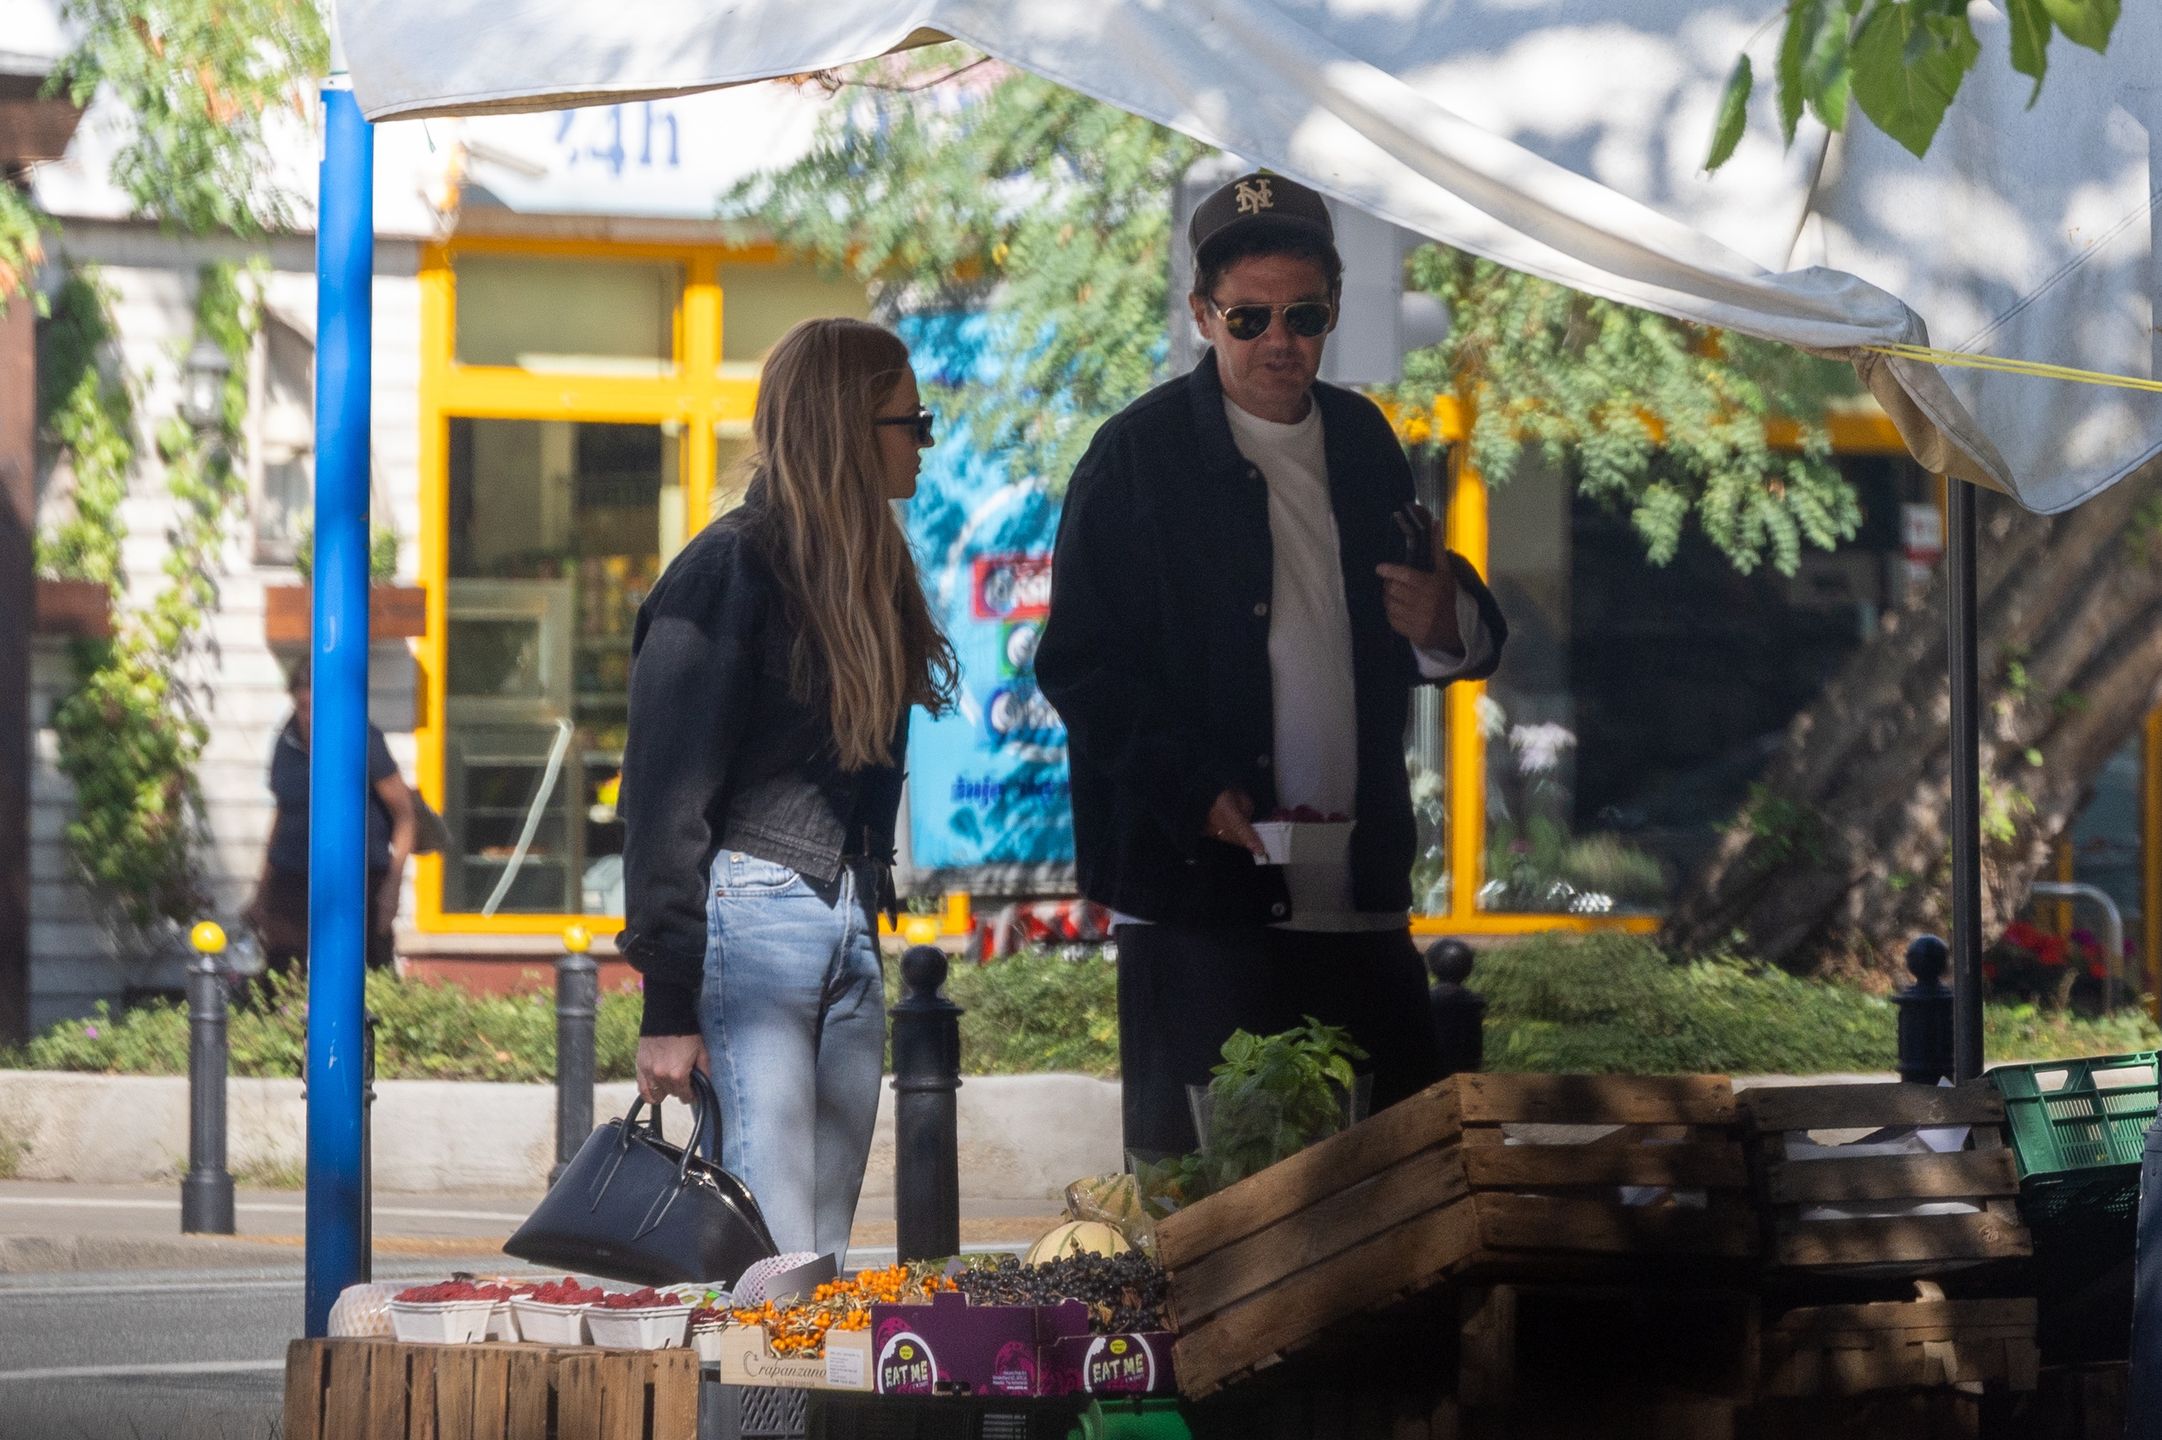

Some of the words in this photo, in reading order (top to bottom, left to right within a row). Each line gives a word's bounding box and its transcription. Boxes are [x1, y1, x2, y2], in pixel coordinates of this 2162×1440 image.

[1234, 178, 1274, 215] NY
[743, 1350, 827, 1378] Crapanzano
[884, 1364, 908, 1388] EAT
[910, 1360, 929, 1382] ME
[1092, 1359, 1120, 1384] EAT
[1123, 1353, 1144, 1376] ME
